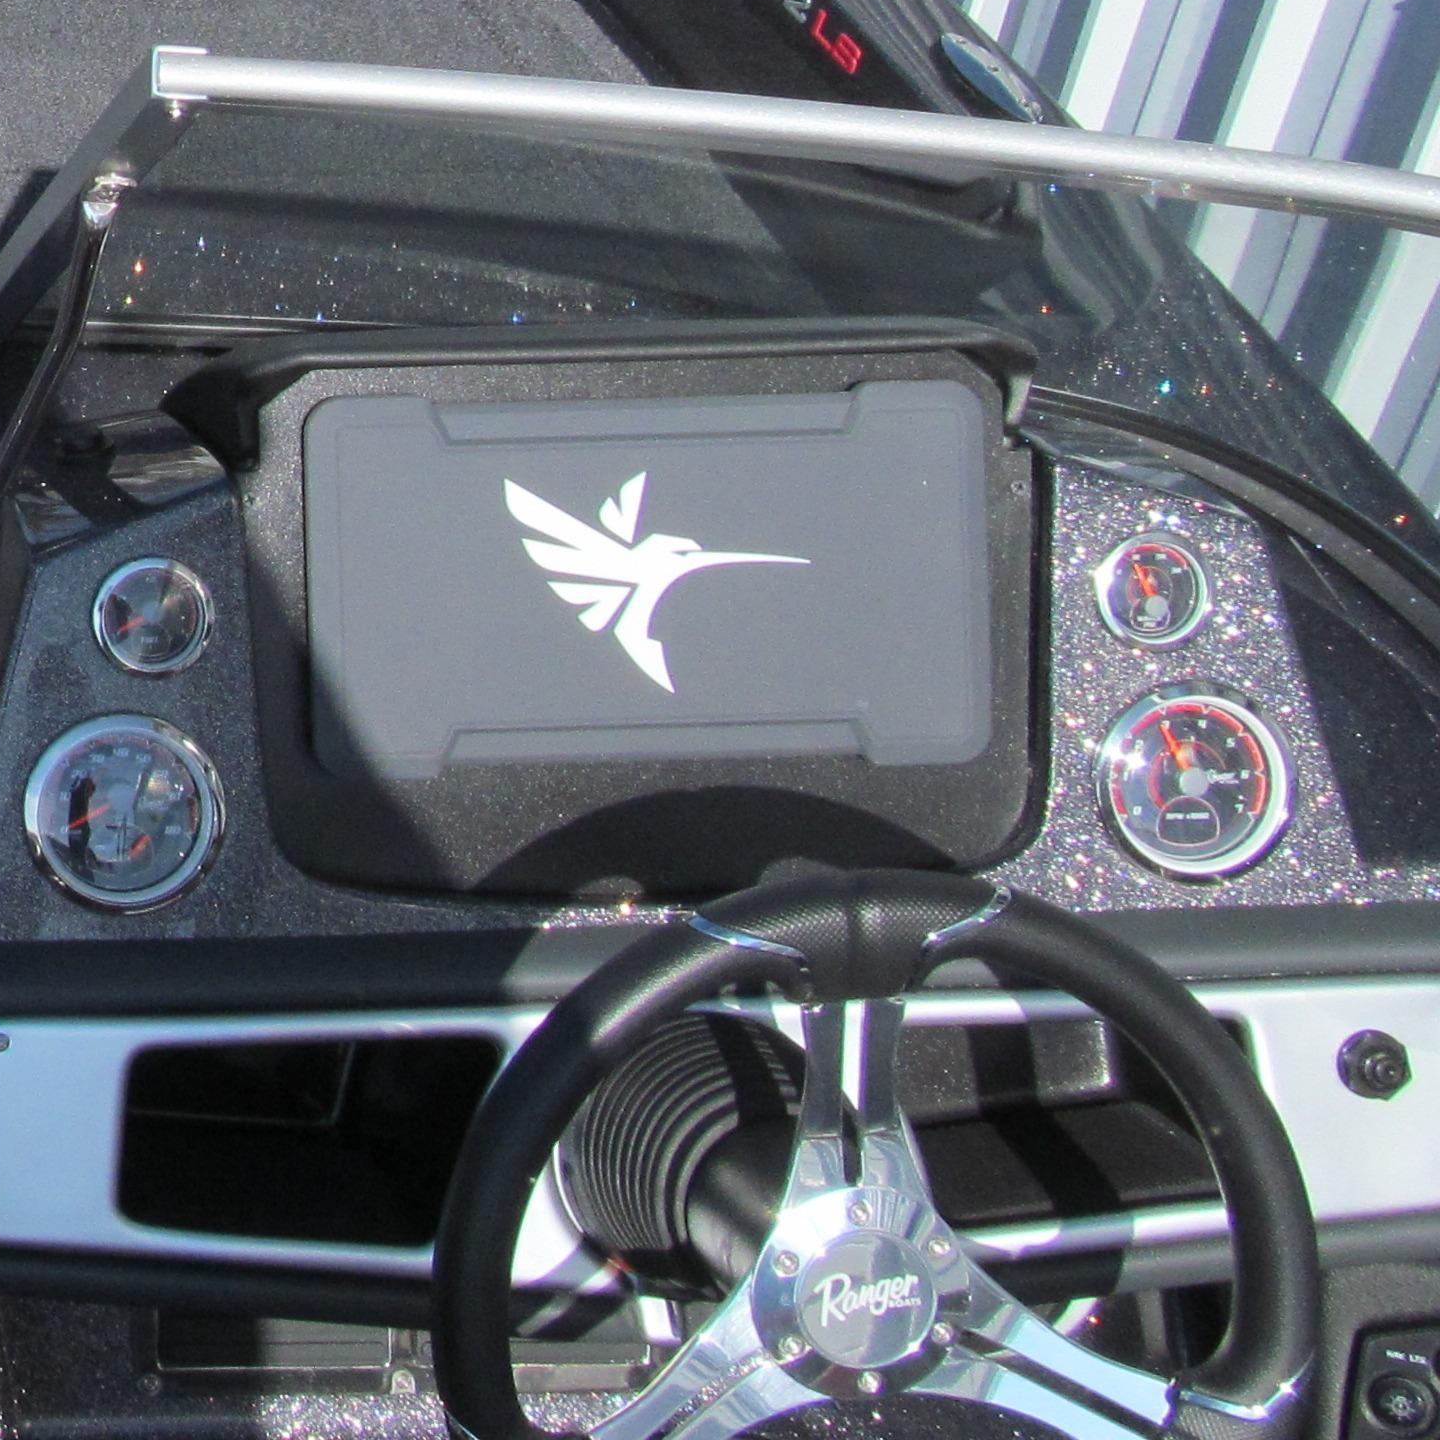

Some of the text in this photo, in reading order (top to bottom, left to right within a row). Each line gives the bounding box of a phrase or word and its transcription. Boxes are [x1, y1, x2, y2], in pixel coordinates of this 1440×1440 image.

[1226, 736, 1237, 748] 5
[1132, 806, 1143, 816] 0
[813, 1273, 919, 1328] Ranger
